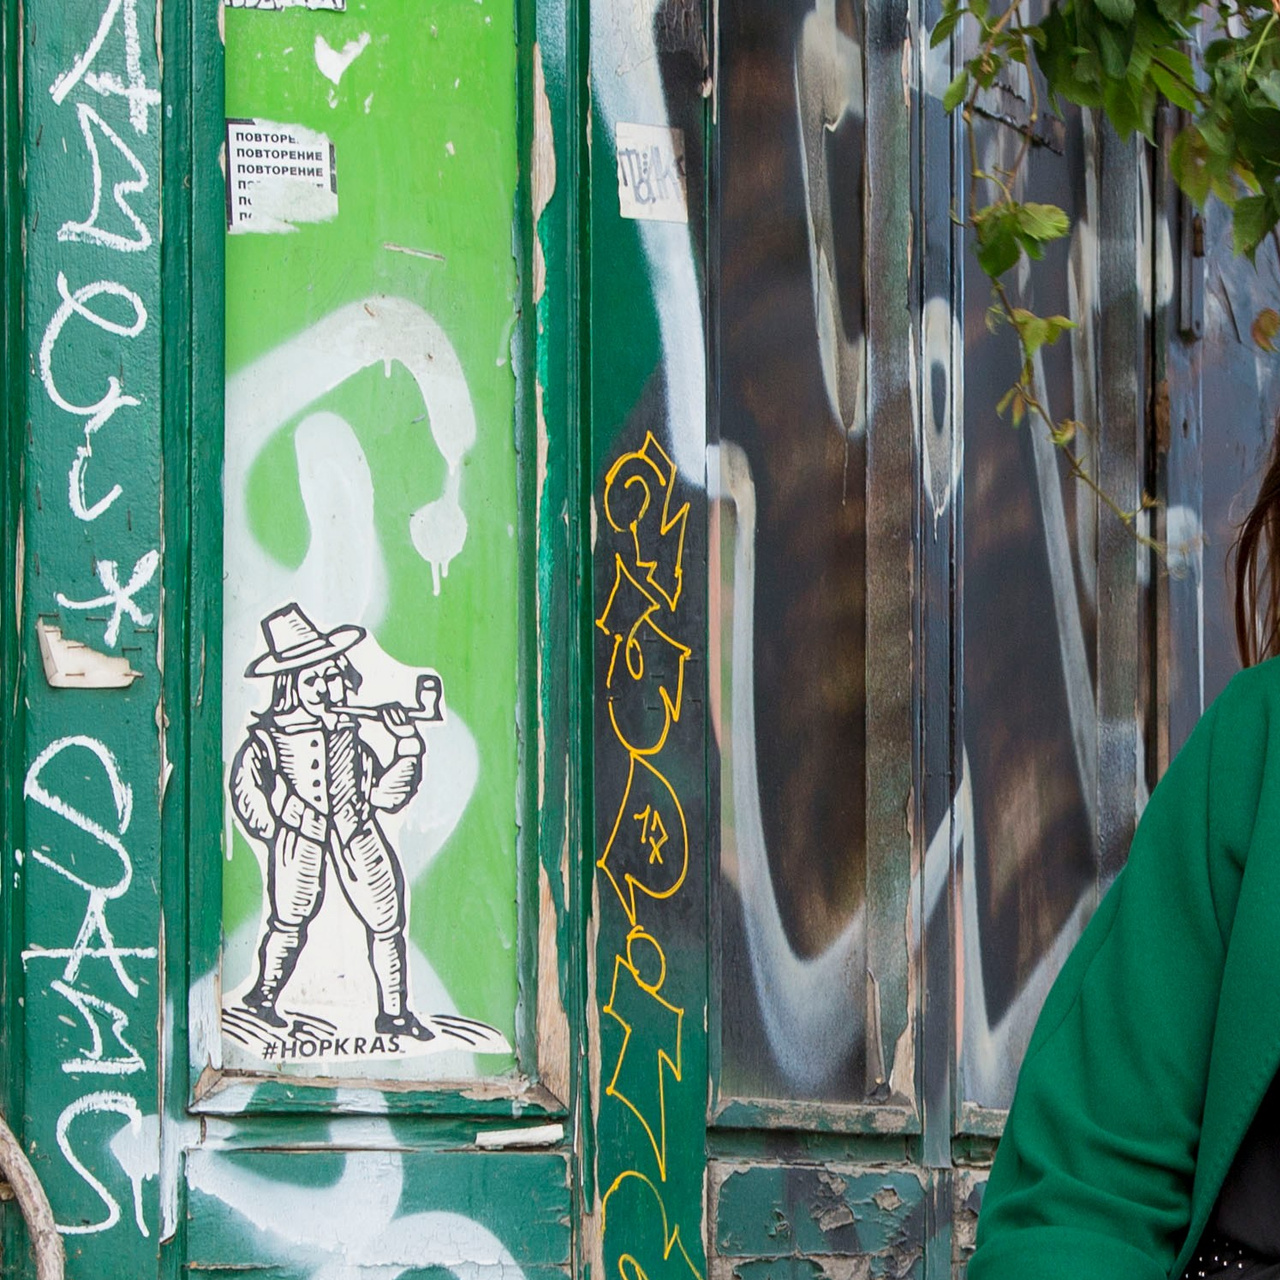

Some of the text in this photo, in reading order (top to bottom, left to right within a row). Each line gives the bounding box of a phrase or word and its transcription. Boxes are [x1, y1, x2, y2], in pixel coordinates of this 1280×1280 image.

[236, 148, 323, 161] ПОВТОРЕНИЕ
[237, 164, 323, 177] ПОВТОРЕНИЕ
[262, 1034, 401, 1060] #HOPKRAS
